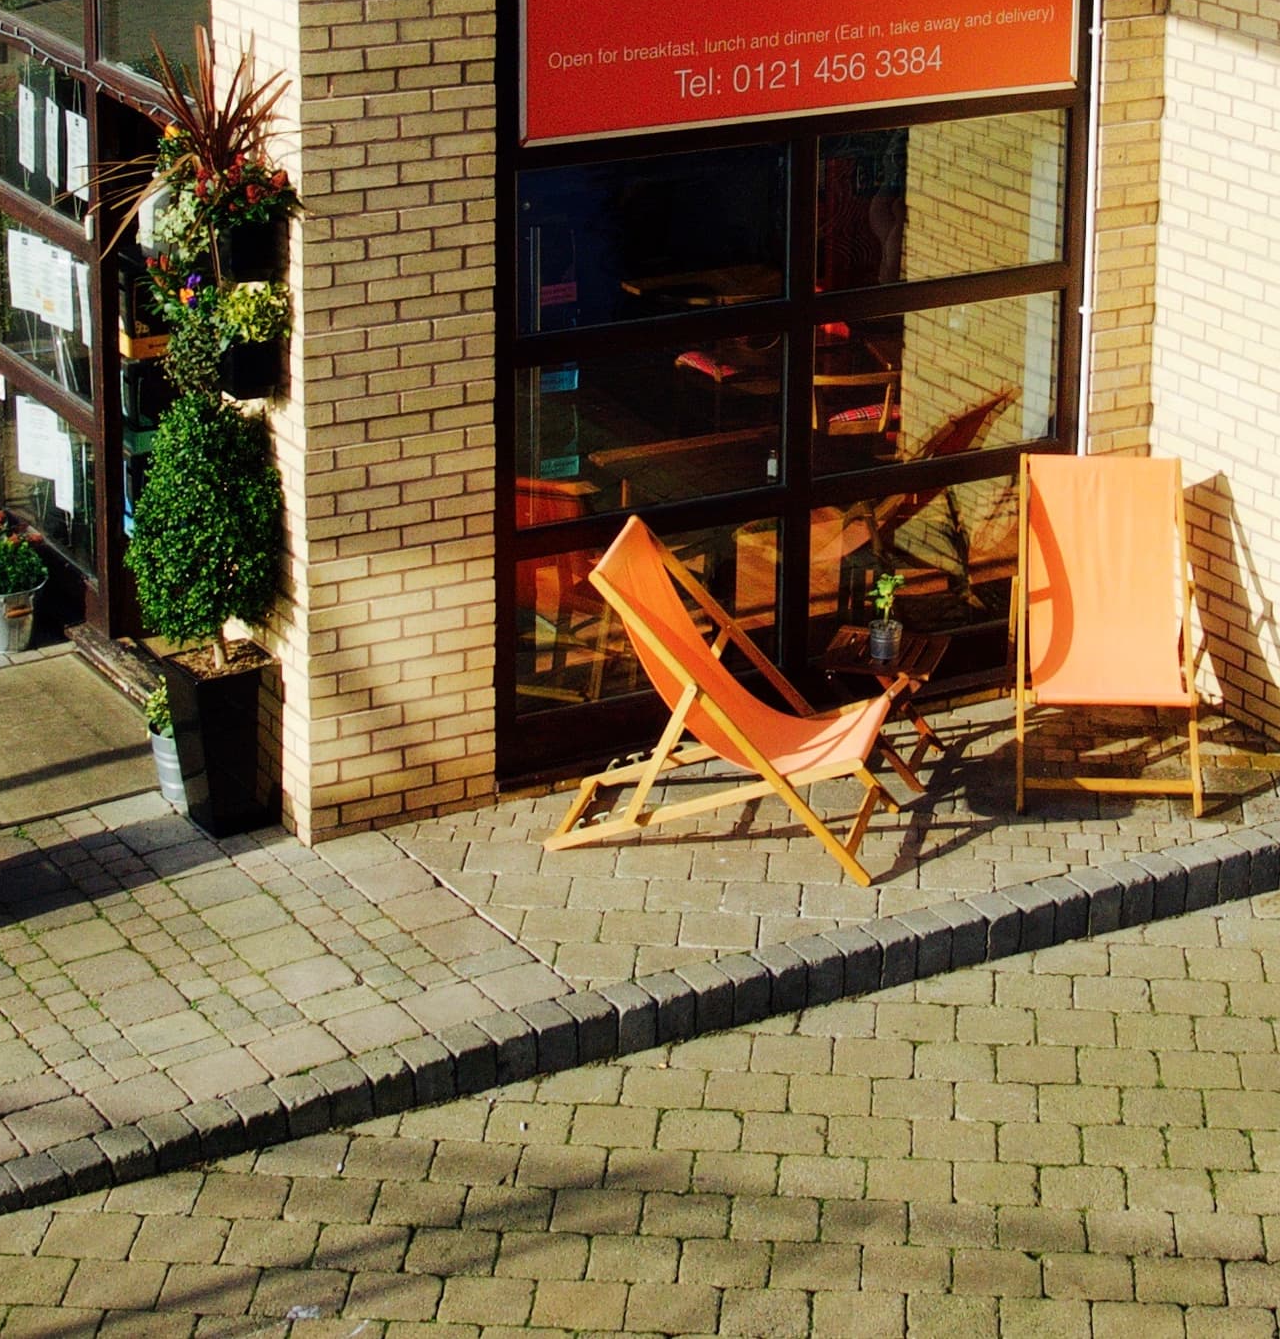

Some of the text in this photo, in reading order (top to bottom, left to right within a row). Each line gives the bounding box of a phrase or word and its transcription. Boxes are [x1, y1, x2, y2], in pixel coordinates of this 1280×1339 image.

[548, 4, 1056, 70] Open for breakfast, lunch and dinner (Eat in, take away and delivery)
[674, 44, 944, 99] Tel: 0121 456 3384
